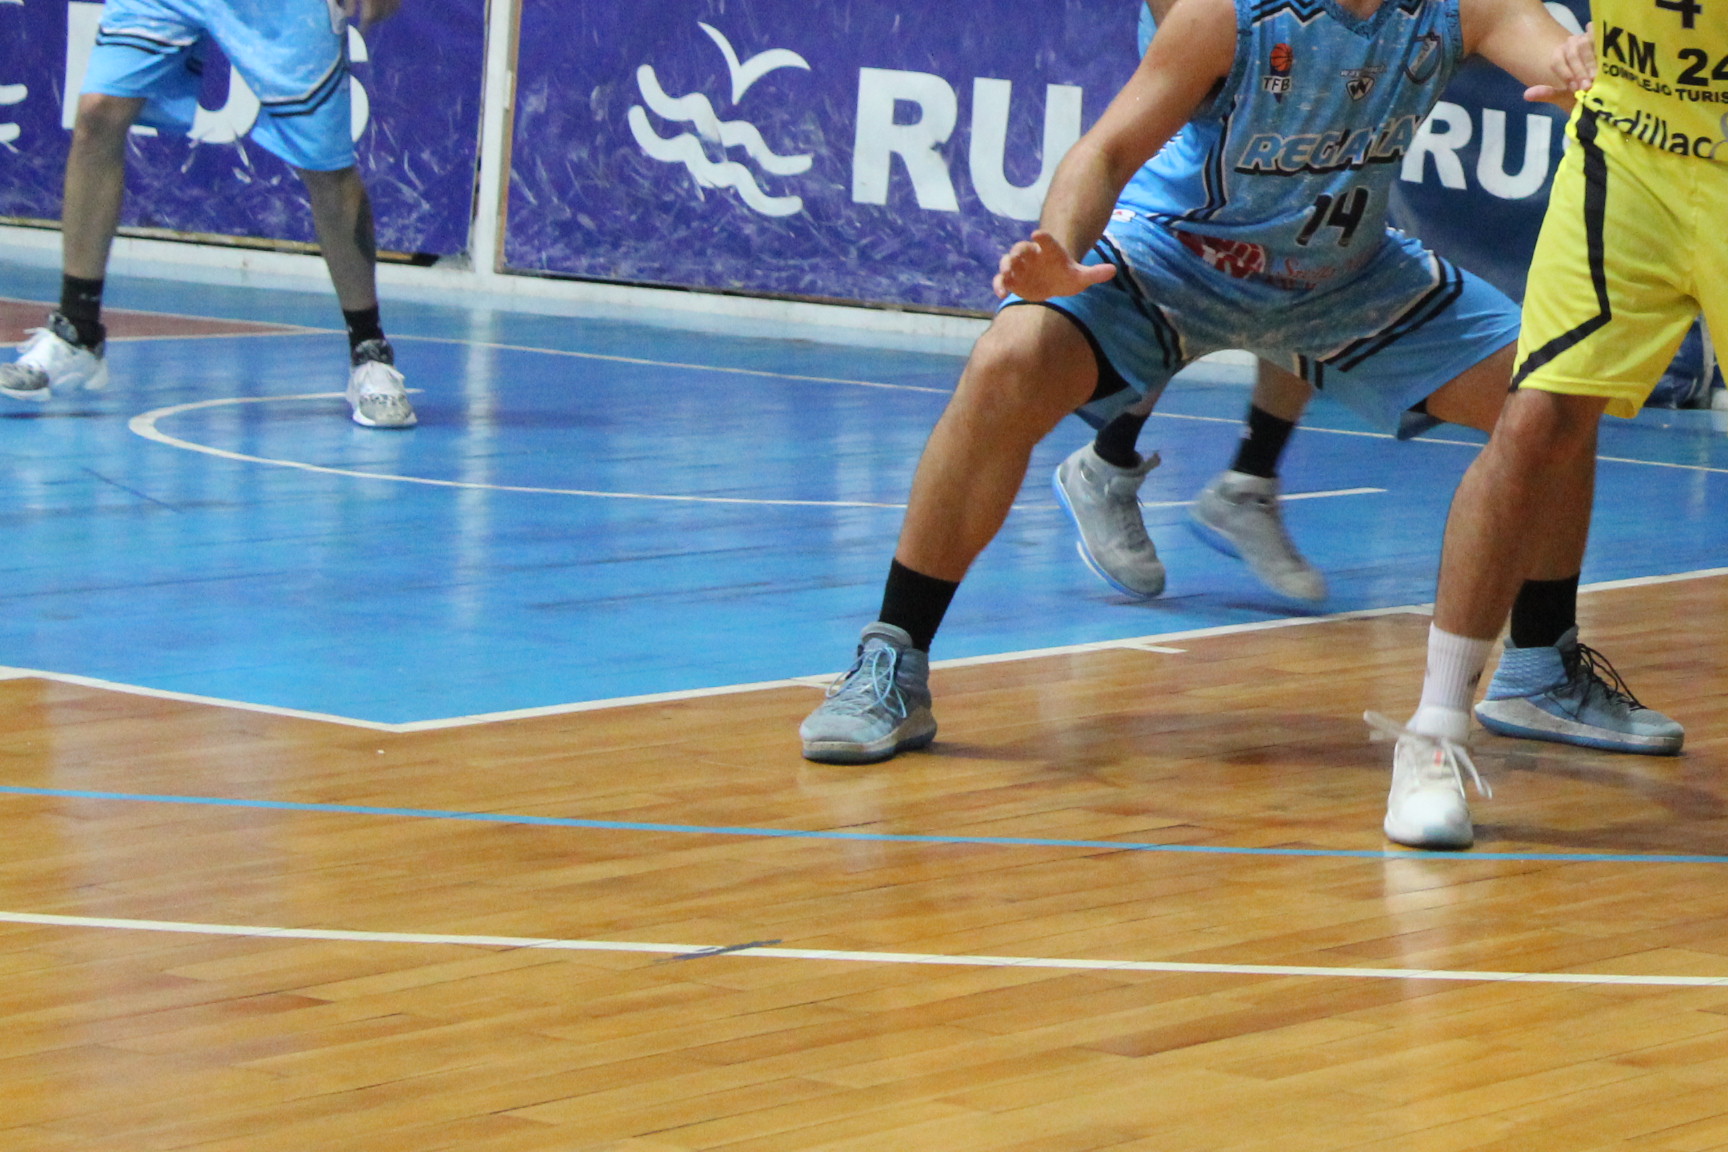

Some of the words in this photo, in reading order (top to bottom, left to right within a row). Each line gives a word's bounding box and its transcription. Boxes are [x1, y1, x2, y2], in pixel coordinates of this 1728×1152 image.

[1602, 19, 1659, 79] KM
[1263, 77, 1291, 92] TFB
[1602, 62, 1672, 97] COMPLEJO
[1401, 100, 1571, 200] RU
[1295, 186, 1369, 247] 14
